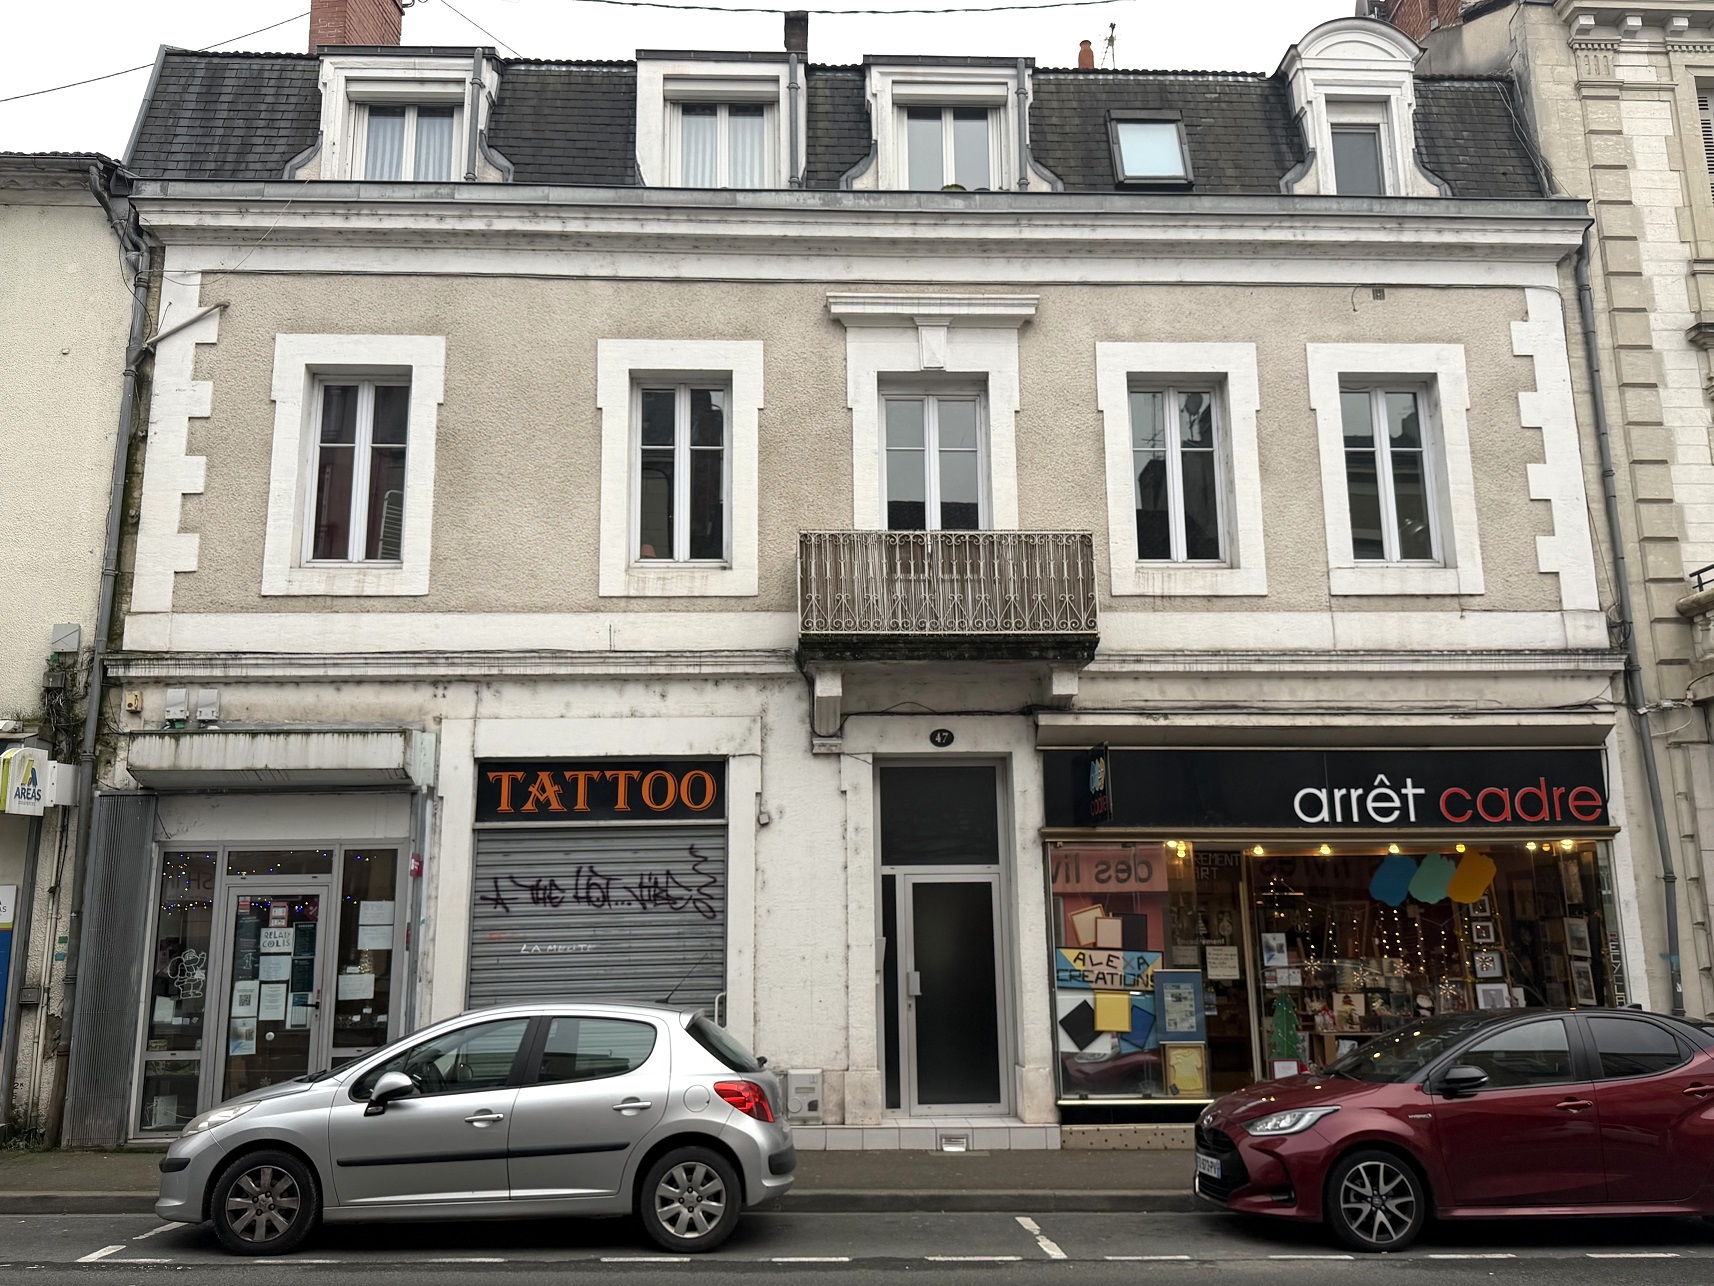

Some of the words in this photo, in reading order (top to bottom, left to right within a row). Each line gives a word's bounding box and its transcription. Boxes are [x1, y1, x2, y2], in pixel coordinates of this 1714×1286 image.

[934, 732, 949, 743] 47
[14, 786, 42, 801] AREAS
[487, 769, 717, 813] TATTOO
[1293, 773, 1426, 823] arrêt
[1439, 776, 1603, 823] cadre
[520, 944, 542, 954] LA
[1073, 951, 1150, 970] ALEXA
